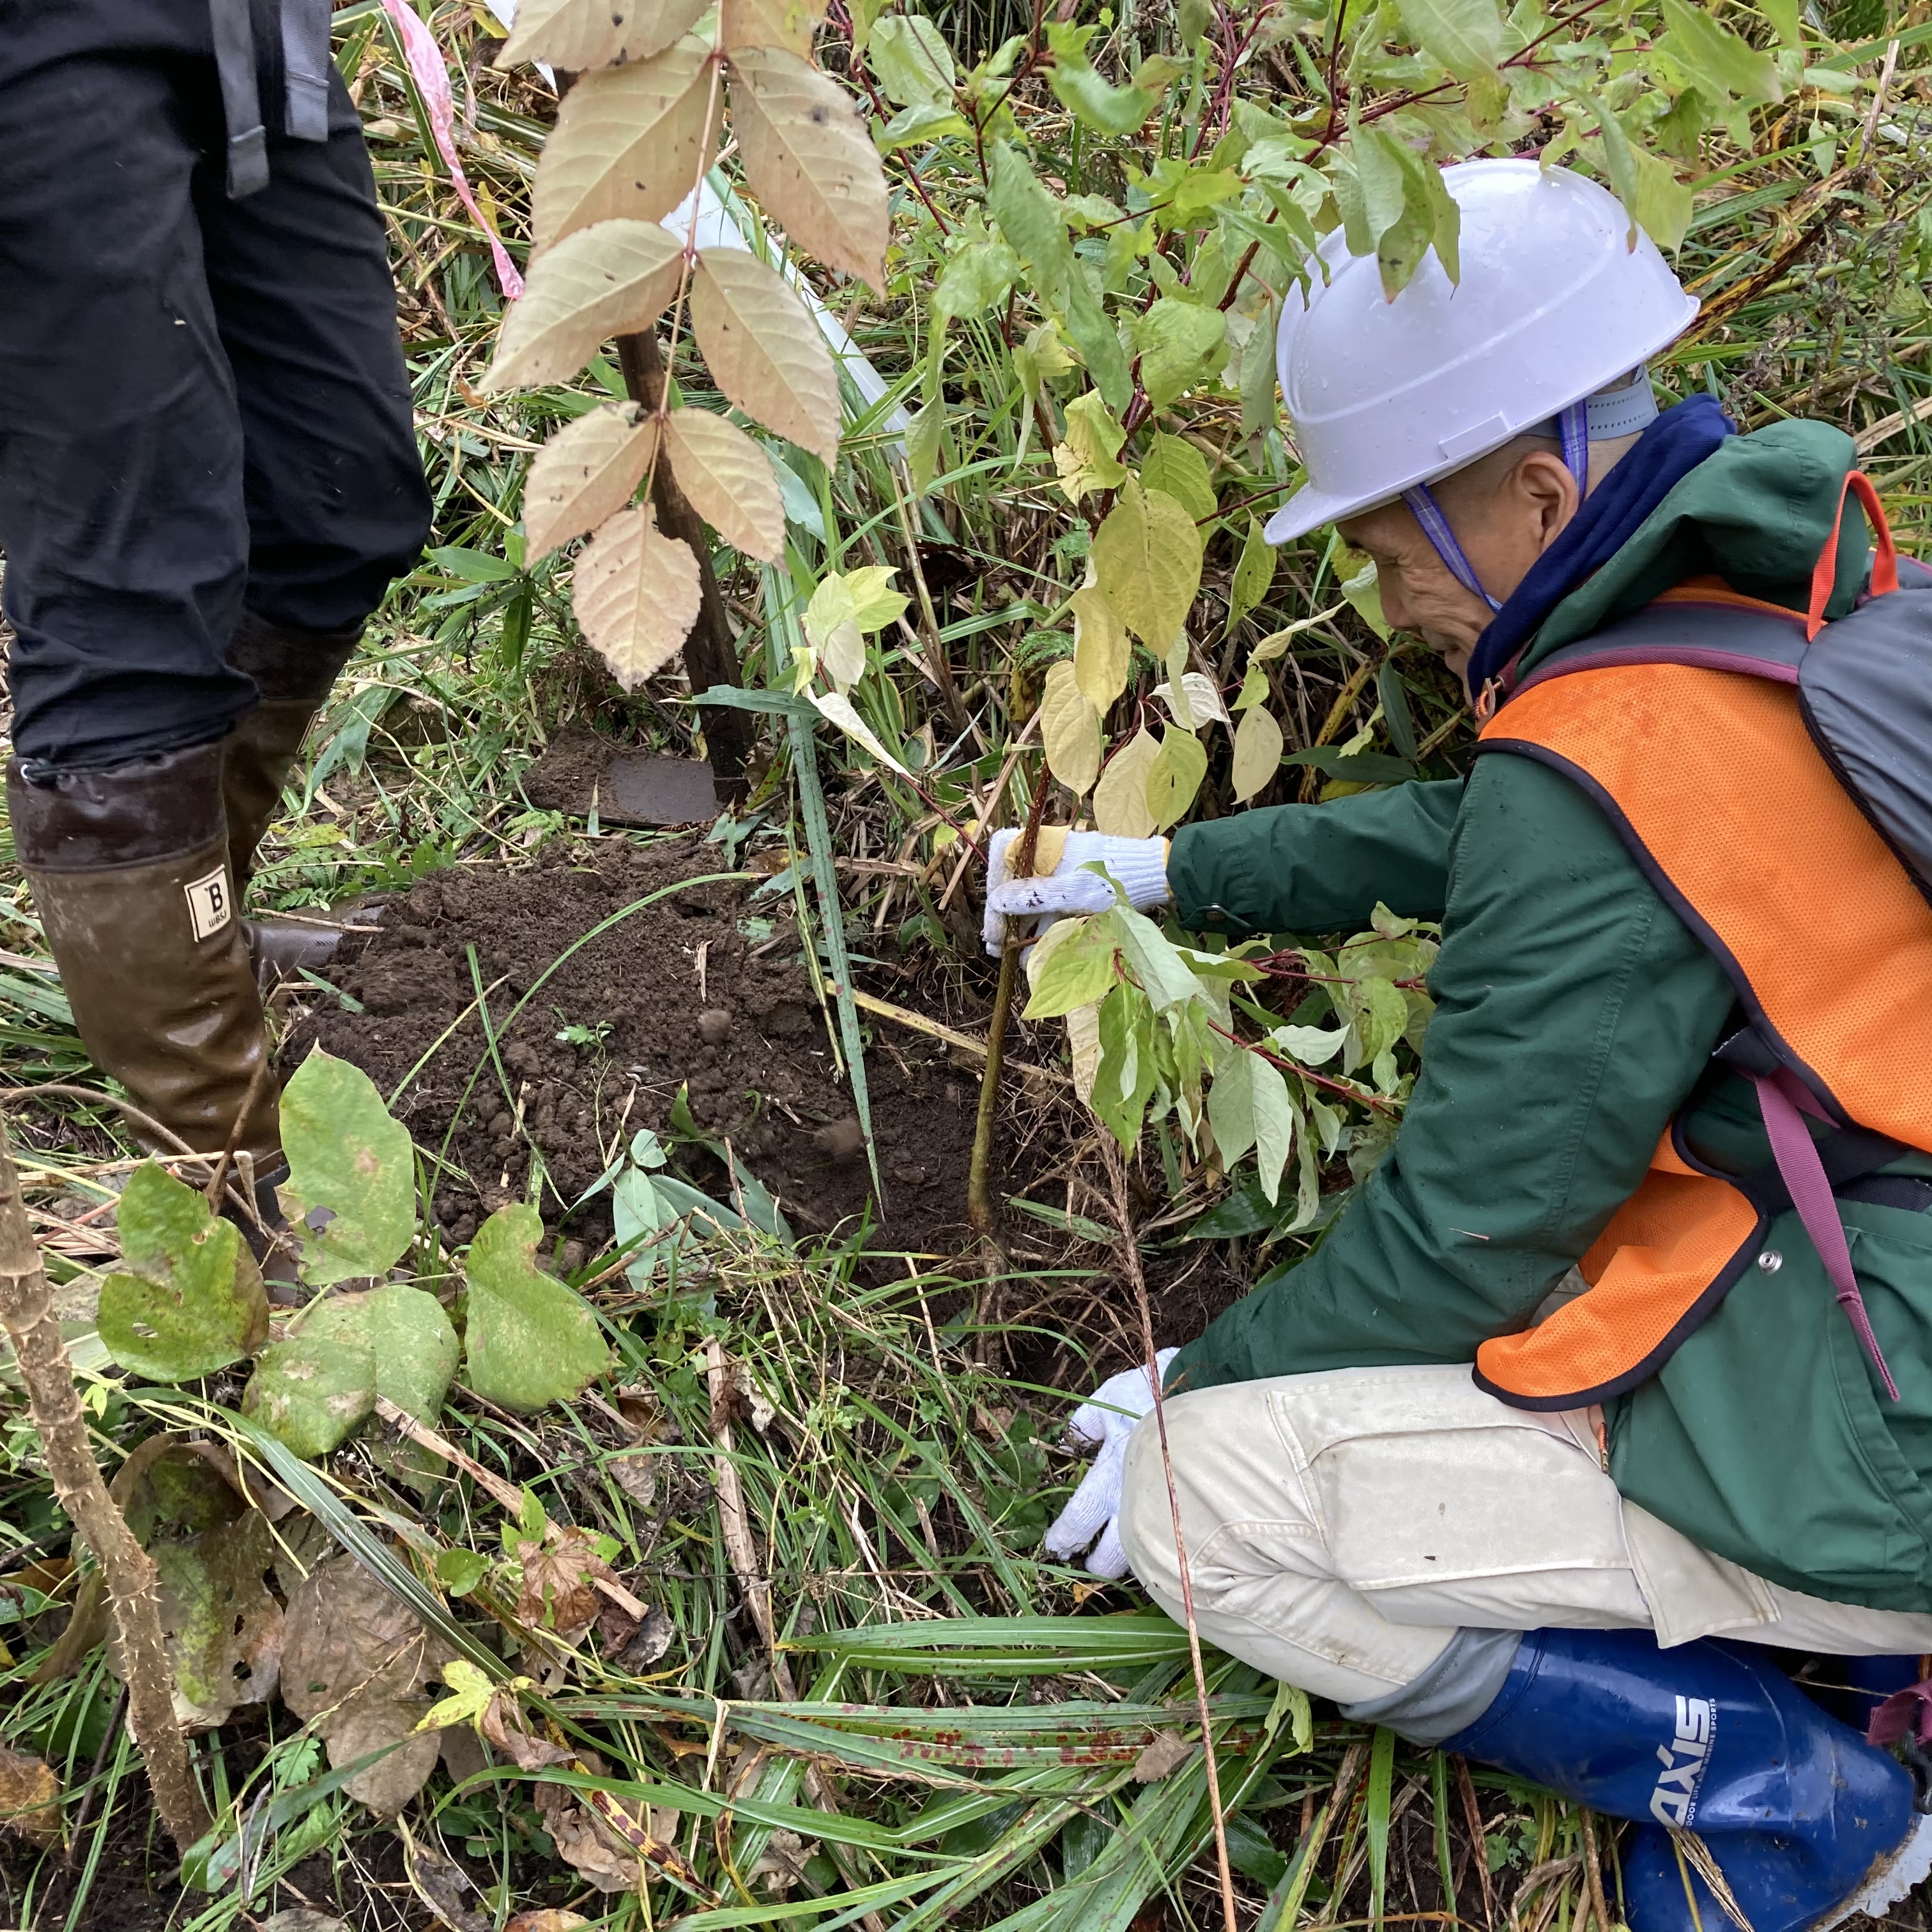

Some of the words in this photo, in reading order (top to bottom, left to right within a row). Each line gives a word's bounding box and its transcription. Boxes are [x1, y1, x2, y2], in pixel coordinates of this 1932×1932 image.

[208, 882, 223, 913] B
[1709, 1698, 1717, 1731] SPORTS
[1650, 1694, 1710, 1828] AXIS
[1703, 1734, 1716, 1765] MARINE
